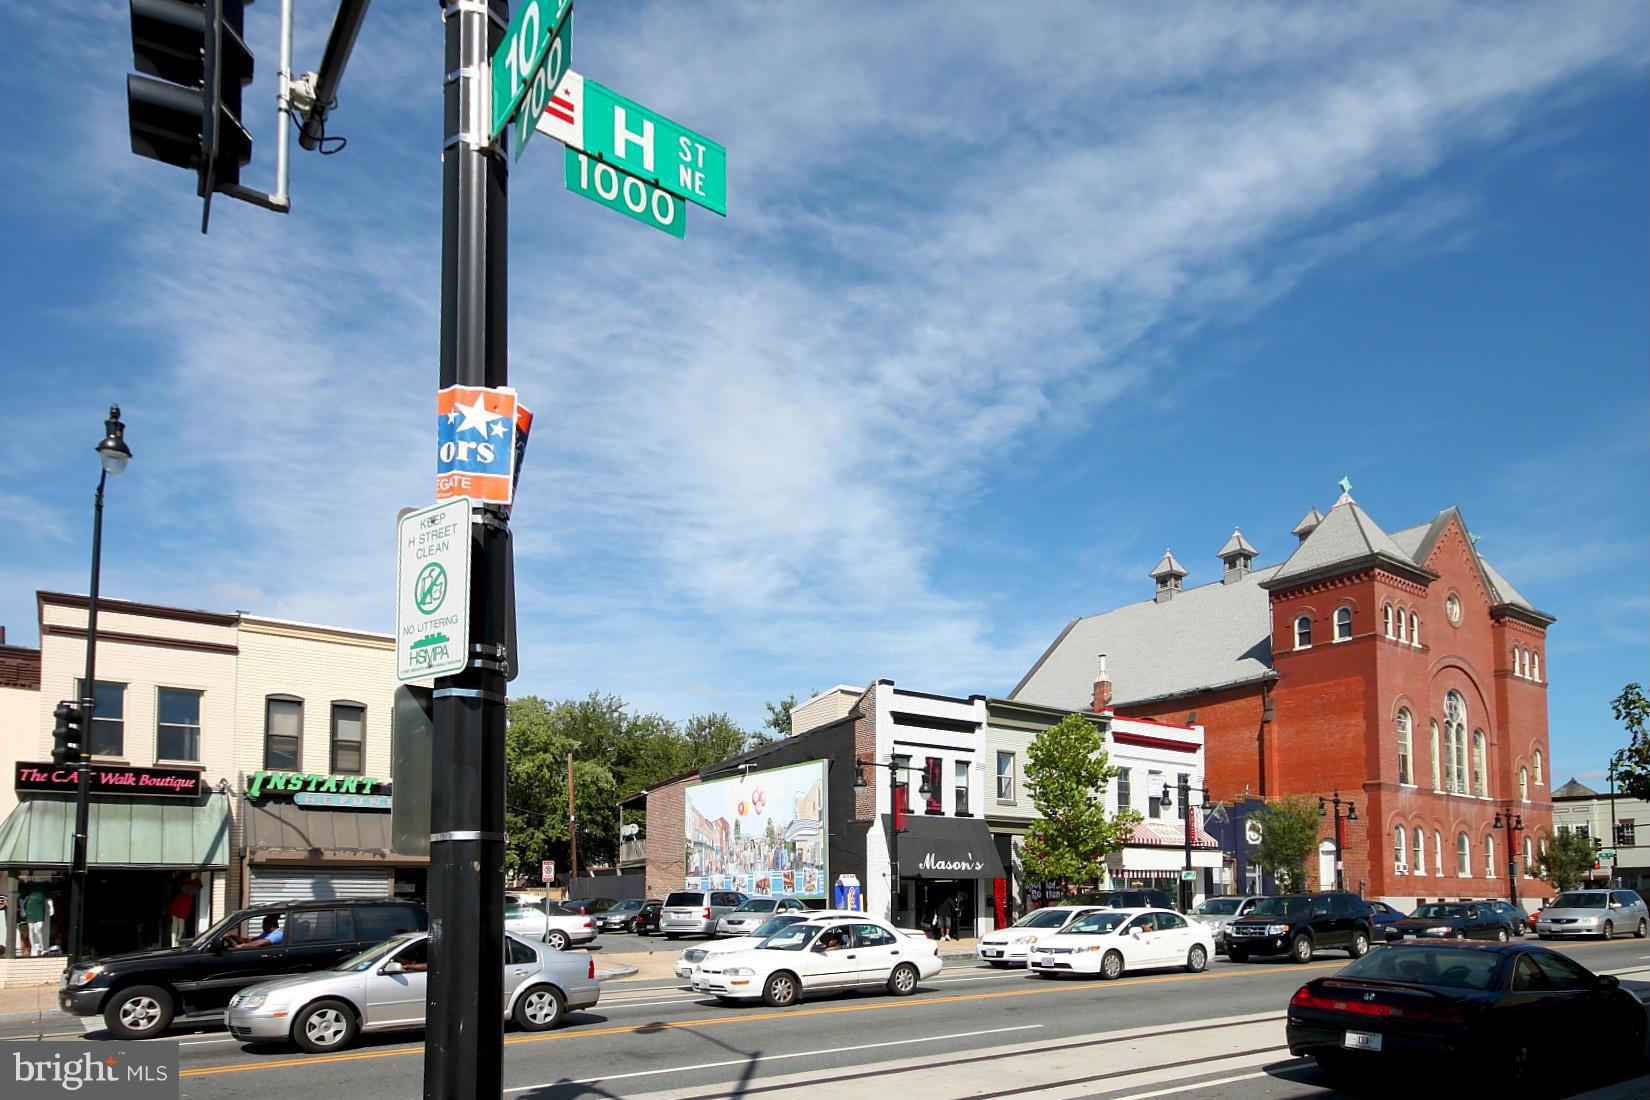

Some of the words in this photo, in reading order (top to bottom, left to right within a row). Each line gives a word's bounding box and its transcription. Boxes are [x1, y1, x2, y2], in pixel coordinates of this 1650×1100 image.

[505, 1, 540, 98] 10
[520, 37, 562, 142] 700
[613, 105, 655, 172] H
[678, 136, 706, 168] ST
[578, 154, 675, 225] 1000
[679, 164, 706, 197] NE
[440, 440, 495, 463] ors
[420, 512, 446, 529] KEEP
[408, 536, 416, 549] H
[419, 522, 458, 545] STREET
[416, 540, 449, 560] CLEAN
[402, 625, 415, 636] NO
[417, 614, 459, 633] LITTERING
[409, 644, 450, 666] HSMPA
[20, 768, 48, 783] The
[100, 772, 136, 786] Walk
[139, 774, 196, 792] Boutique
[247, 770, 378, 798] INSTANT
[919, 852, 985, 870] Mason's
